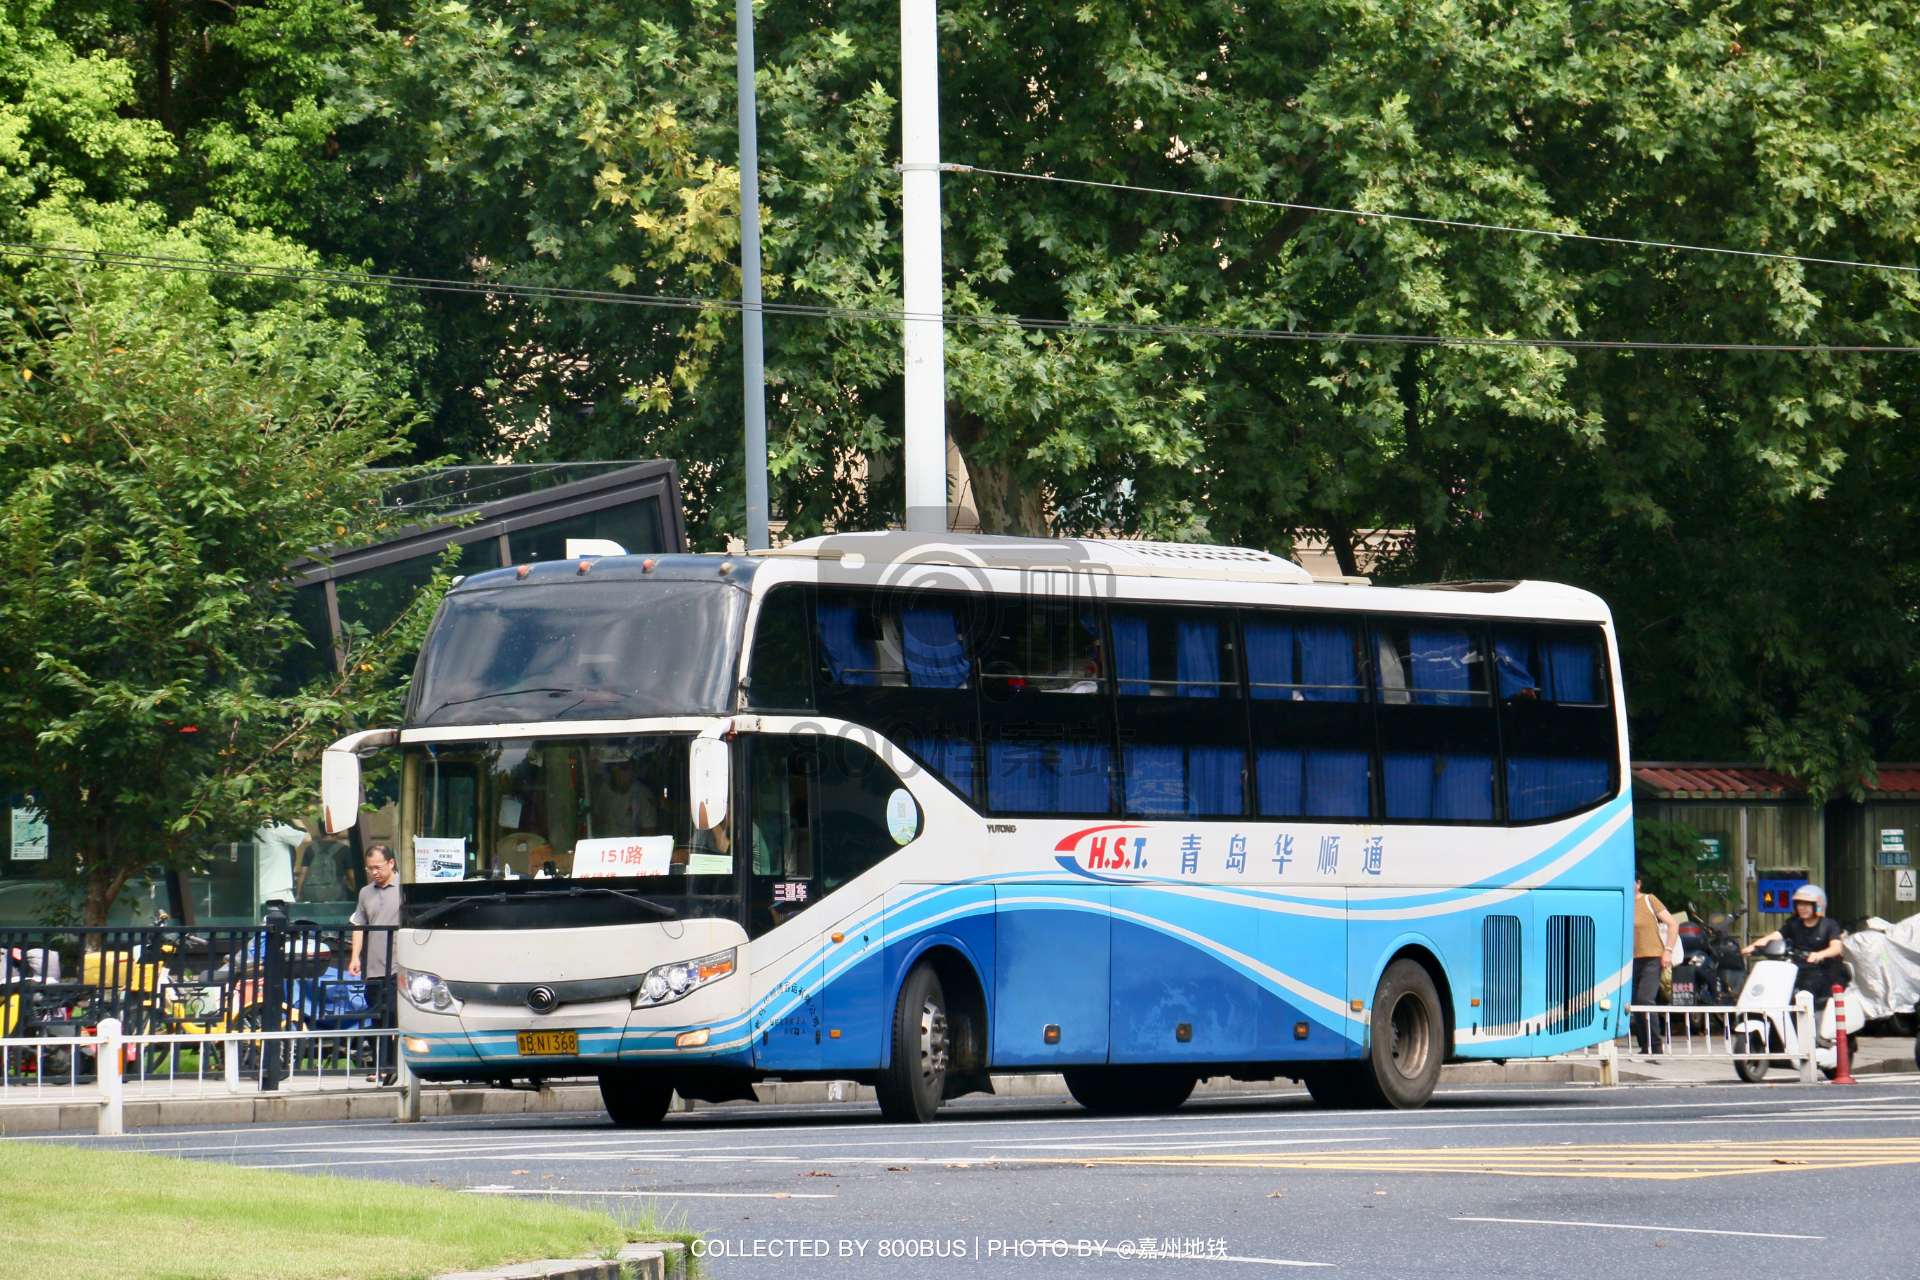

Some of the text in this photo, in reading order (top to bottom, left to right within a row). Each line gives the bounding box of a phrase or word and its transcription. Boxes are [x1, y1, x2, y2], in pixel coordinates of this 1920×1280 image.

[986, 825, 1017, 834] YUTONG
[601, 845, 643, 865] 151路
[1088, 836, 1148, 869] H.S.T.
[1180, 833, 1384, 876] 青岛华顺通
[774, 882, 807, 902] 三型车
